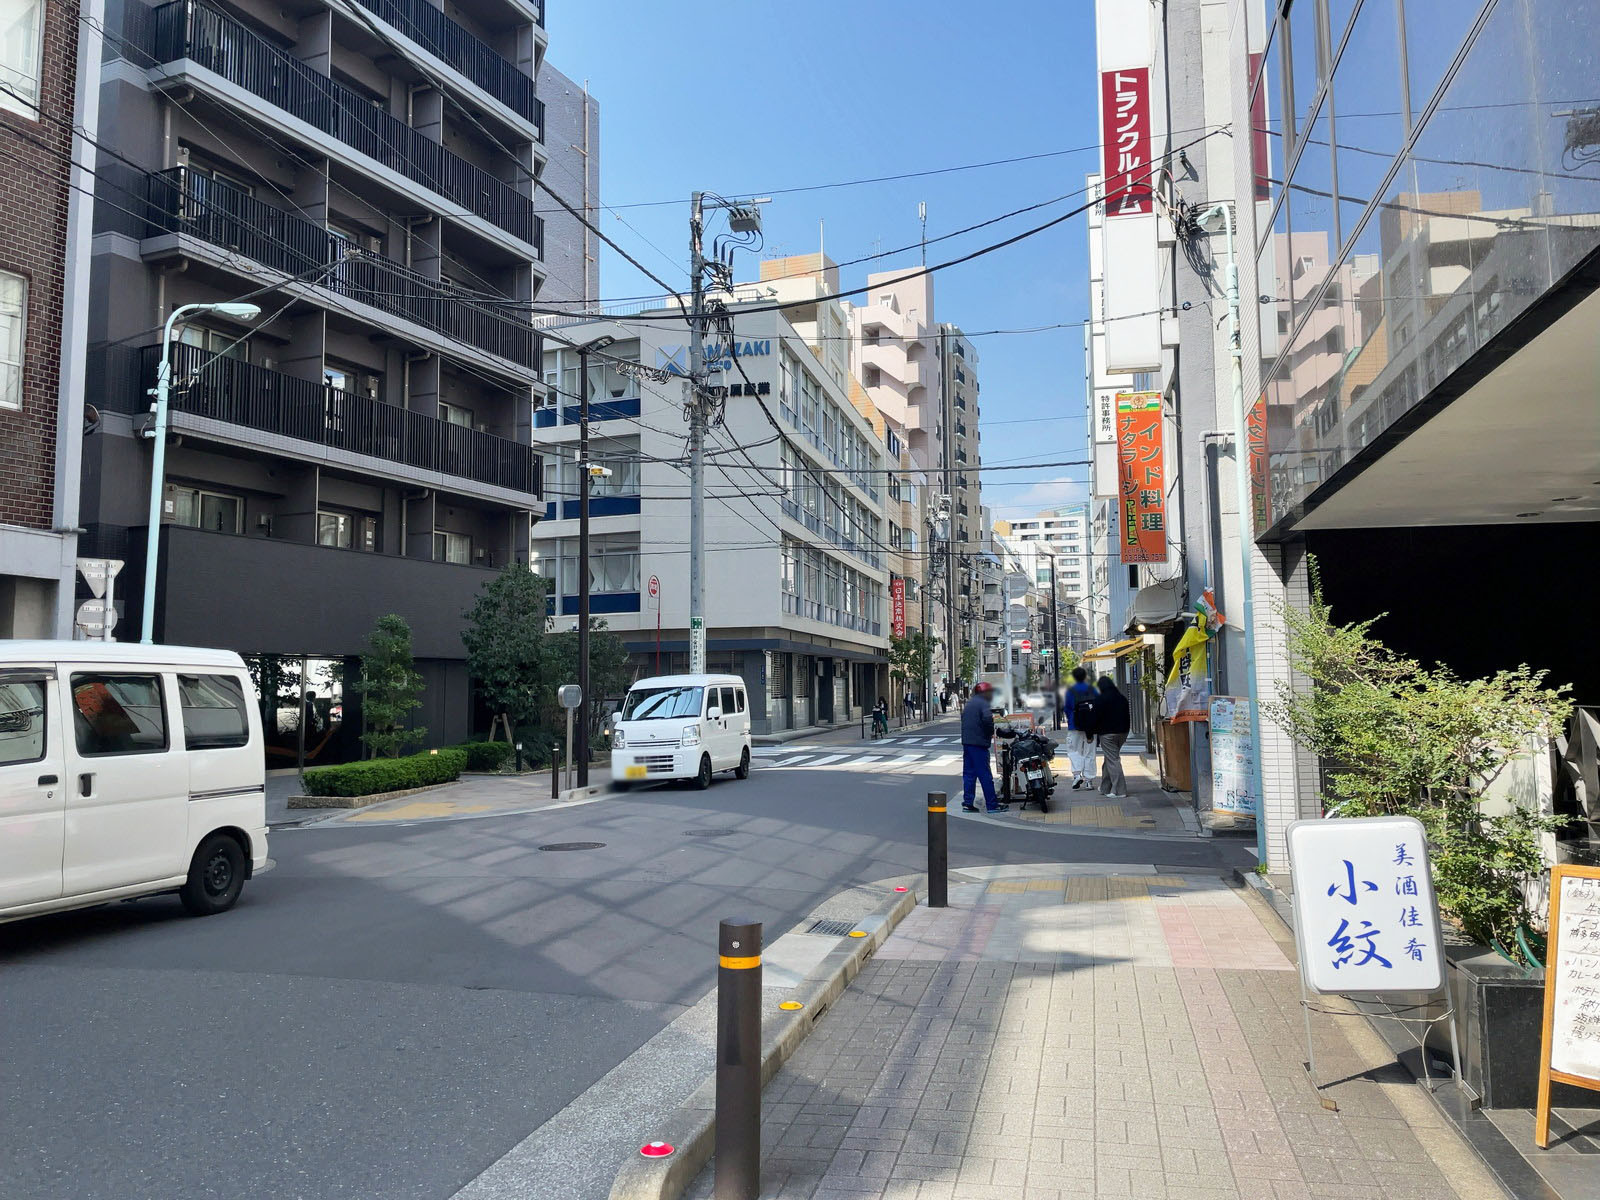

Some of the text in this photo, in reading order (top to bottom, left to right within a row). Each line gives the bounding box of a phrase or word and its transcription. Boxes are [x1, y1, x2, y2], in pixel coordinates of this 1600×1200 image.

[1115, 72, 1142, 214] トランクルーム
[1101, 395, 1111, 432] 特許事務所
[1120, 416, 1138, 495] ナタラージ
[1139, 423, 1164, 531] インド料理
[1326, 859, 1393, 970] 小紋
[1392, 843, 1426, 961] 美酒佳肴
